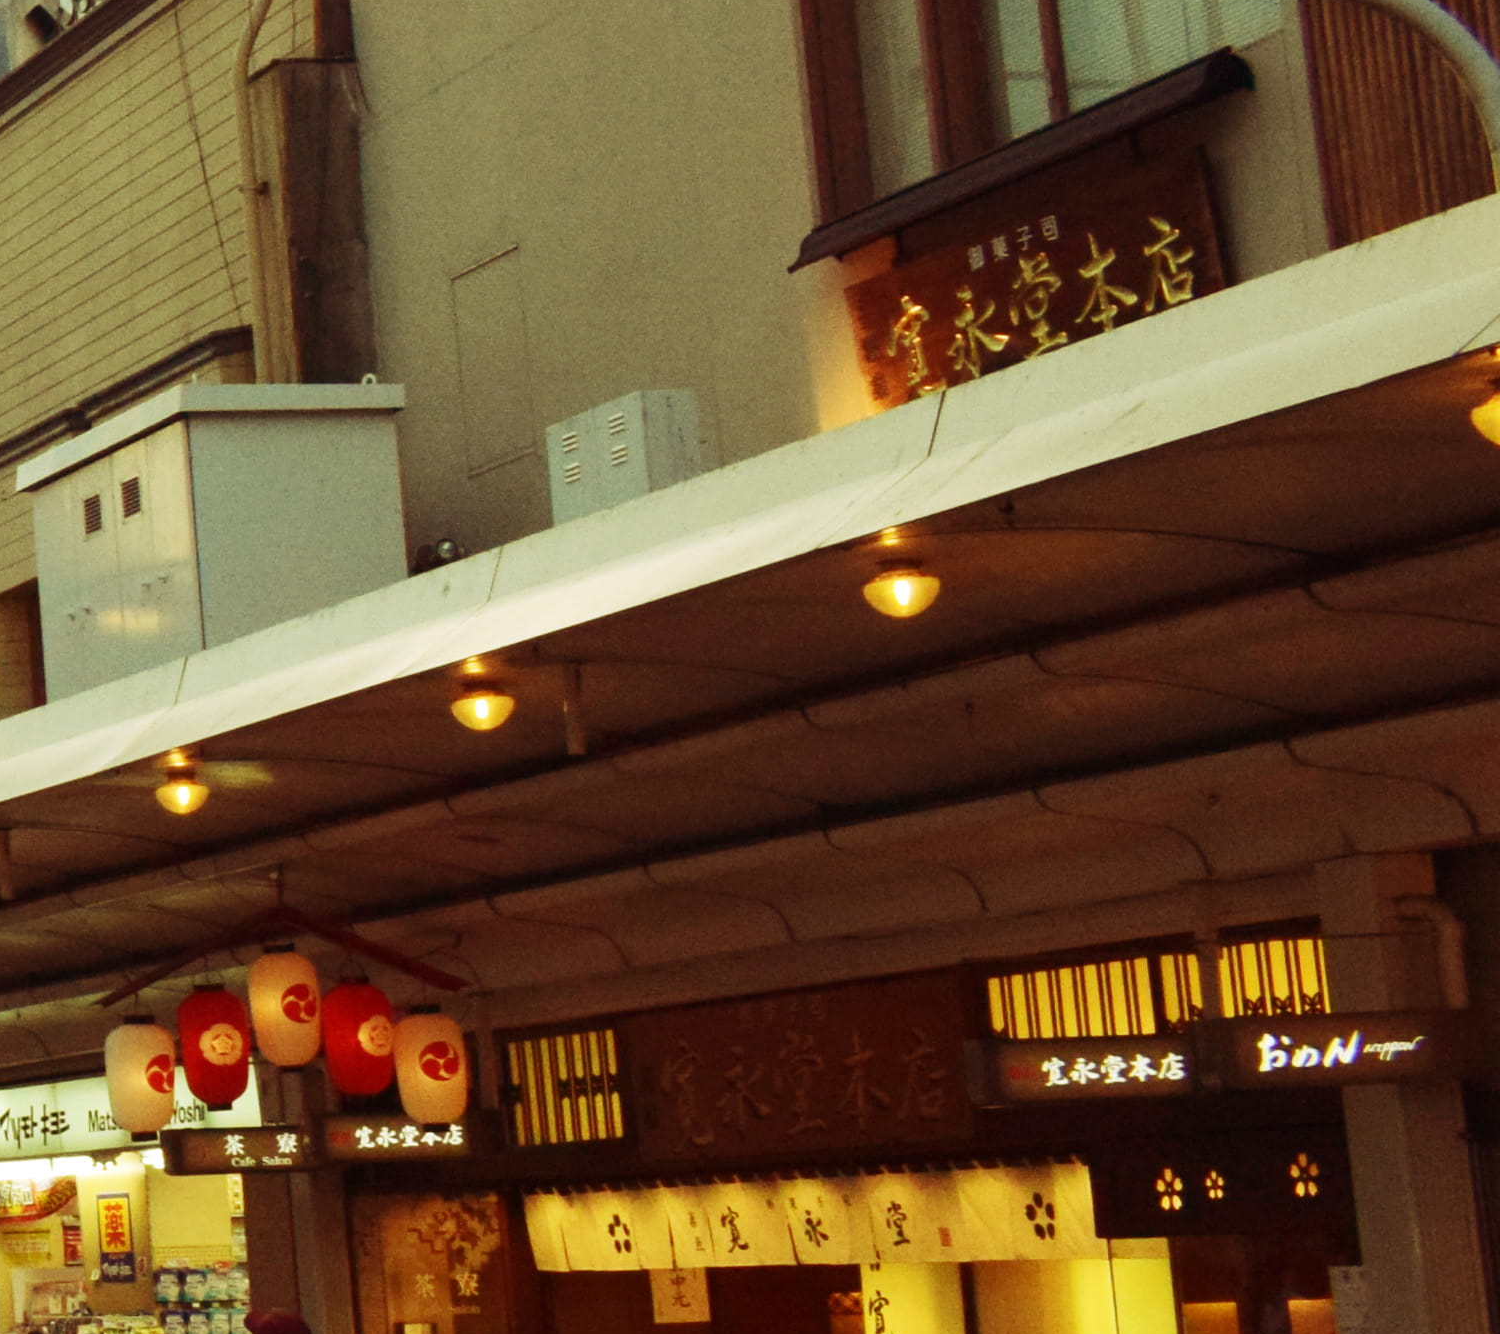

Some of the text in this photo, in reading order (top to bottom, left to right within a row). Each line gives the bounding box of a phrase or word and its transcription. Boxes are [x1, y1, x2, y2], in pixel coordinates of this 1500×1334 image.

[1041, 1052, 1187, 1087] 寛永堂本店
[230, 1155, 256, 1168] Cafe
[102, 1201, 128, 1249] 薬
